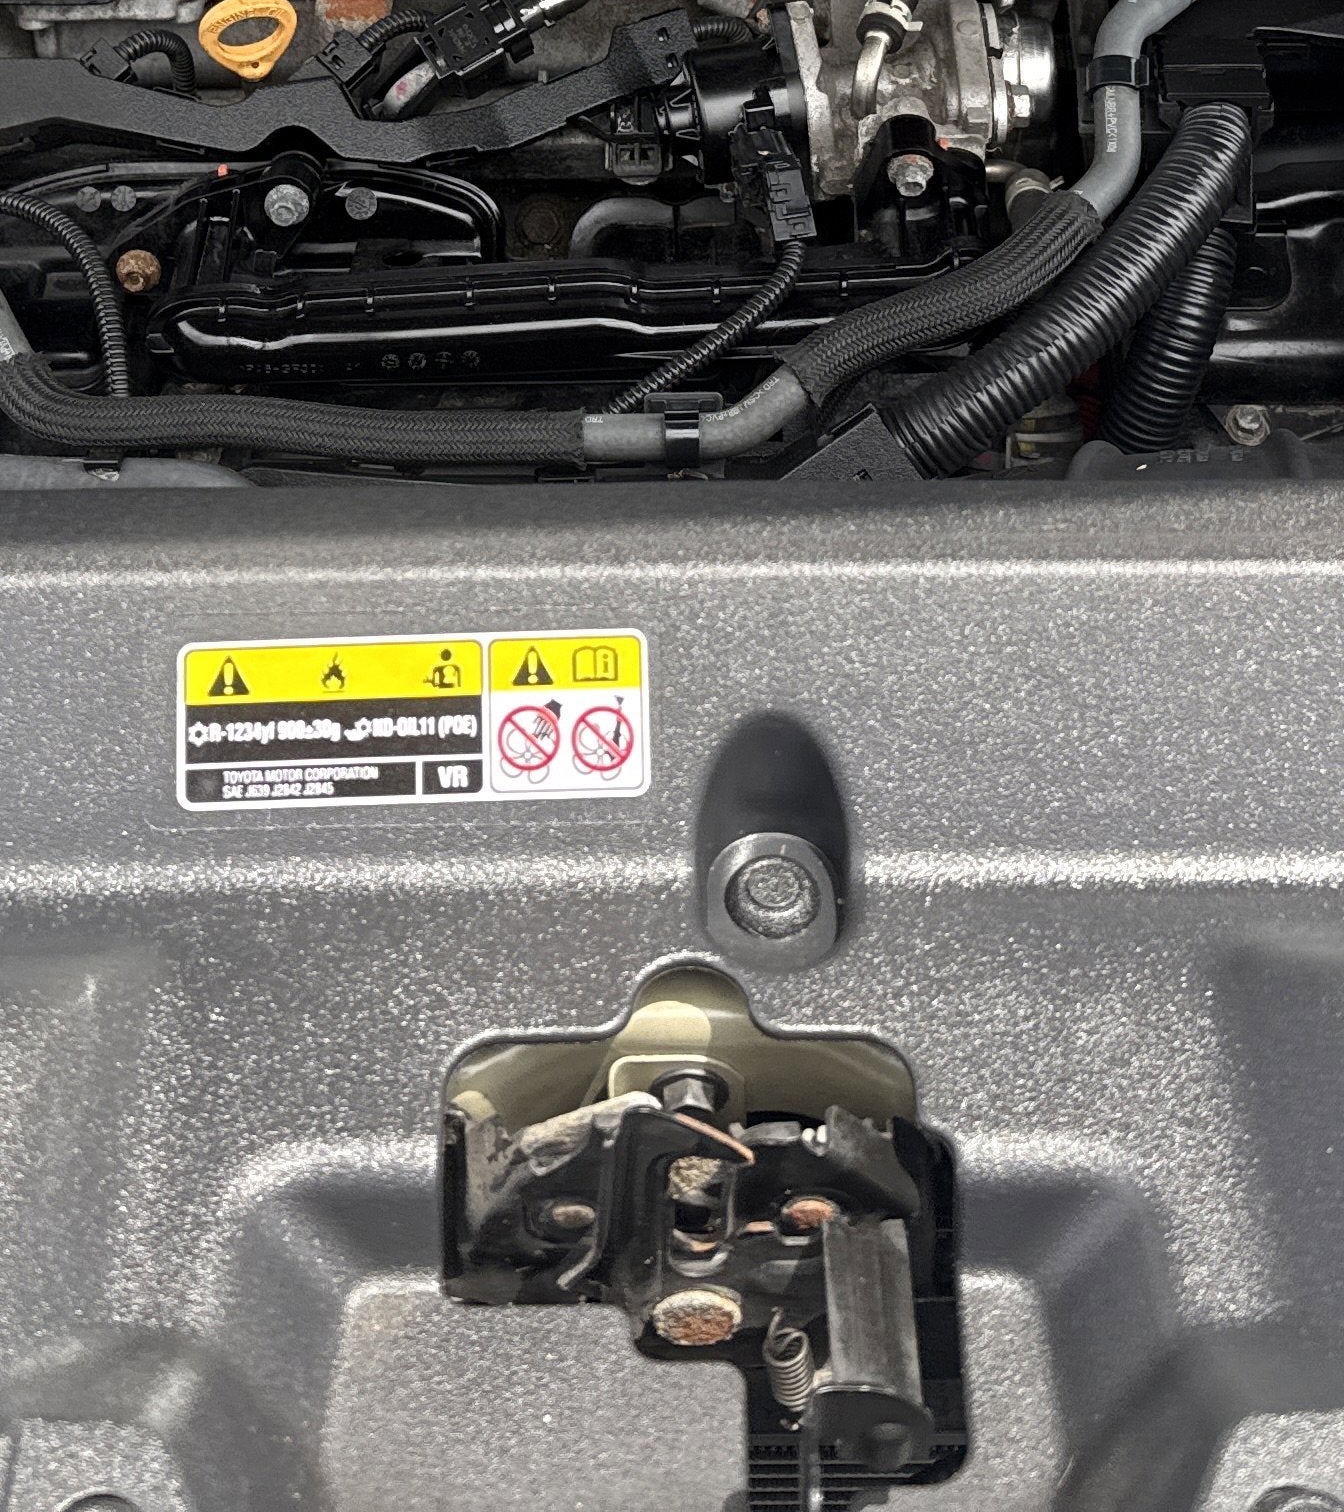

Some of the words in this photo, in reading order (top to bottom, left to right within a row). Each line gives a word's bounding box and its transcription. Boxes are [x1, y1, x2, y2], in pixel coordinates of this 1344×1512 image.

[438, 714, 478, 738] (POE)
[222, 770, 264, 783] TOYOTA
[264, 768, 303, 782] MOTOR
[304, 766, 379, 781] CORPORATION
[437, 765, 469, 788] VR
[222, 785, 244, 799] SAE
